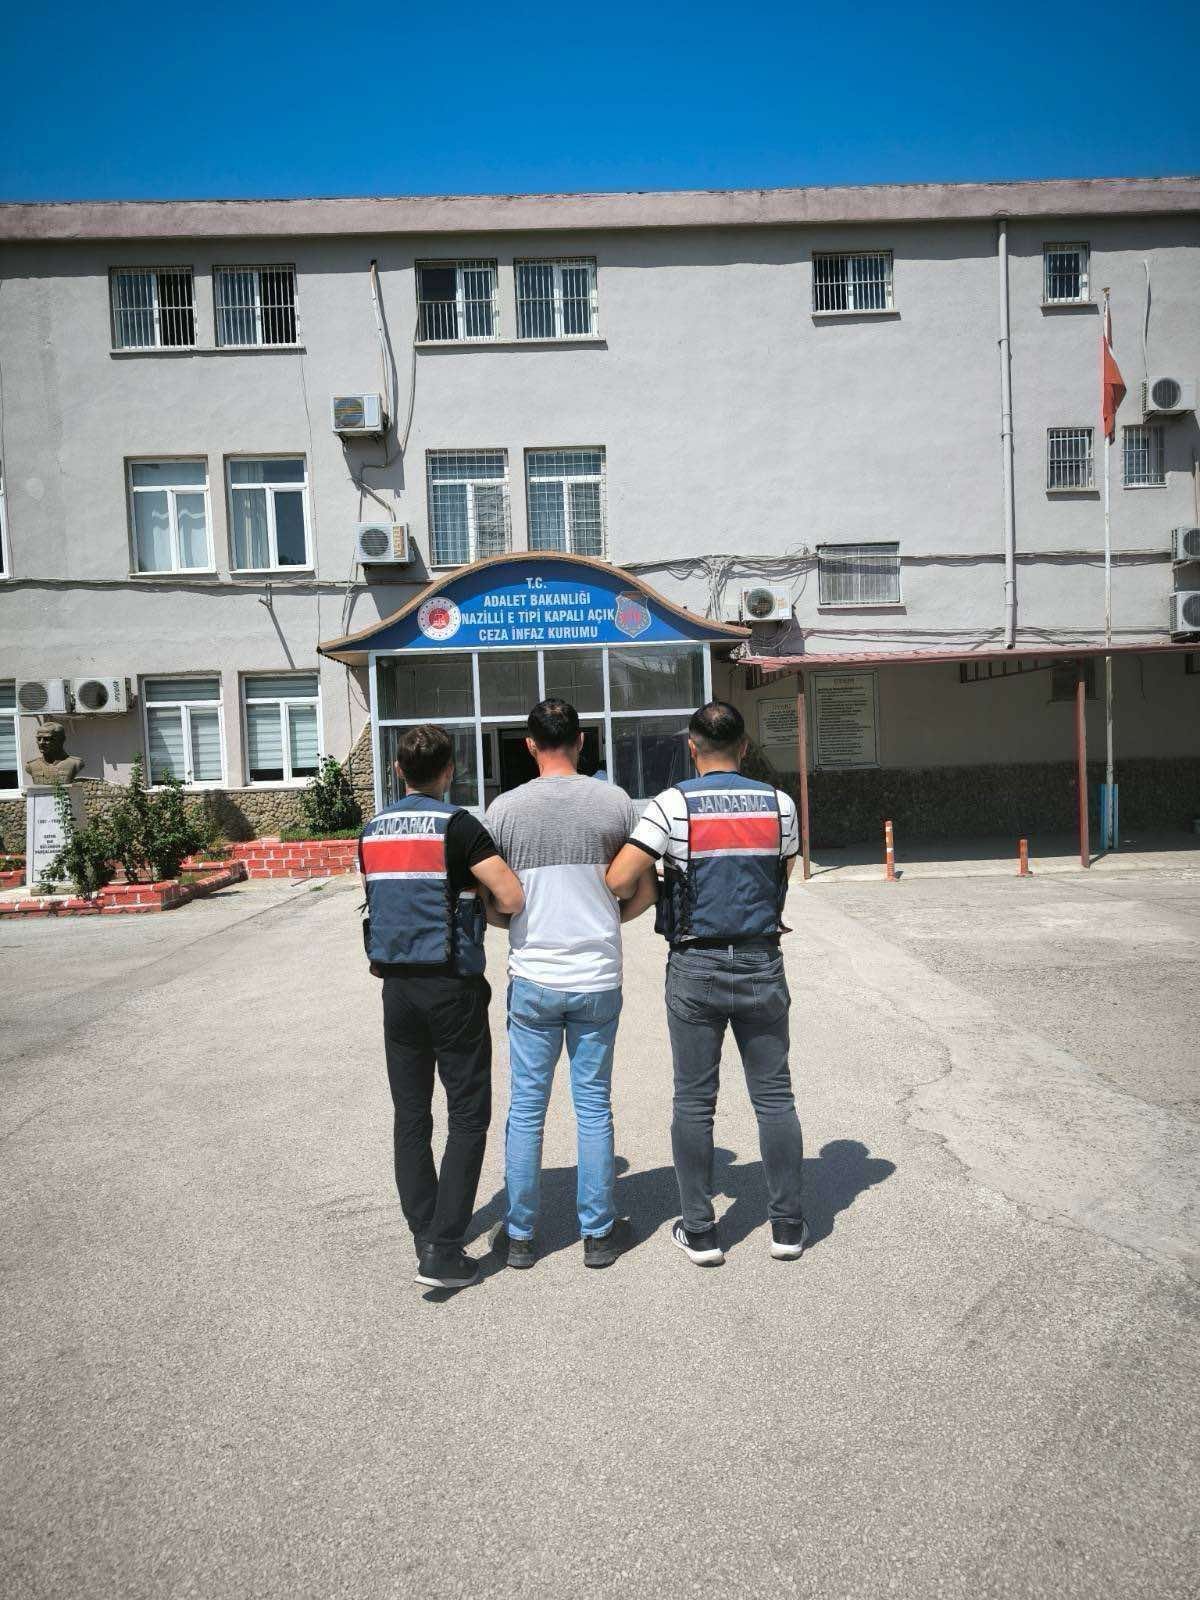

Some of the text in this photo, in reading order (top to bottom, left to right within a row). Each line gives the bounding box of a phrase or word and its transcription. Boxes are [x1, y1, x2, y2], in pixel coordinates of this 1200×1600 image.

[525, 577, 547, 589] T.C.
[483, 590, 591, 607] ADALET BAKANLIĞI
[462, 609, 504, 625] NAZİLLİ
[508, 612, 515, 623] E
[545, 609, 584, 623] KAPALI
[587, 608, 615, 624] AÇIK
[479, 626, 598, 641] CEZA İNFAZ KURUMU
[697, 795, 770, 813] JANDARMA
[371, 816, 437, 836] JANDARMA
